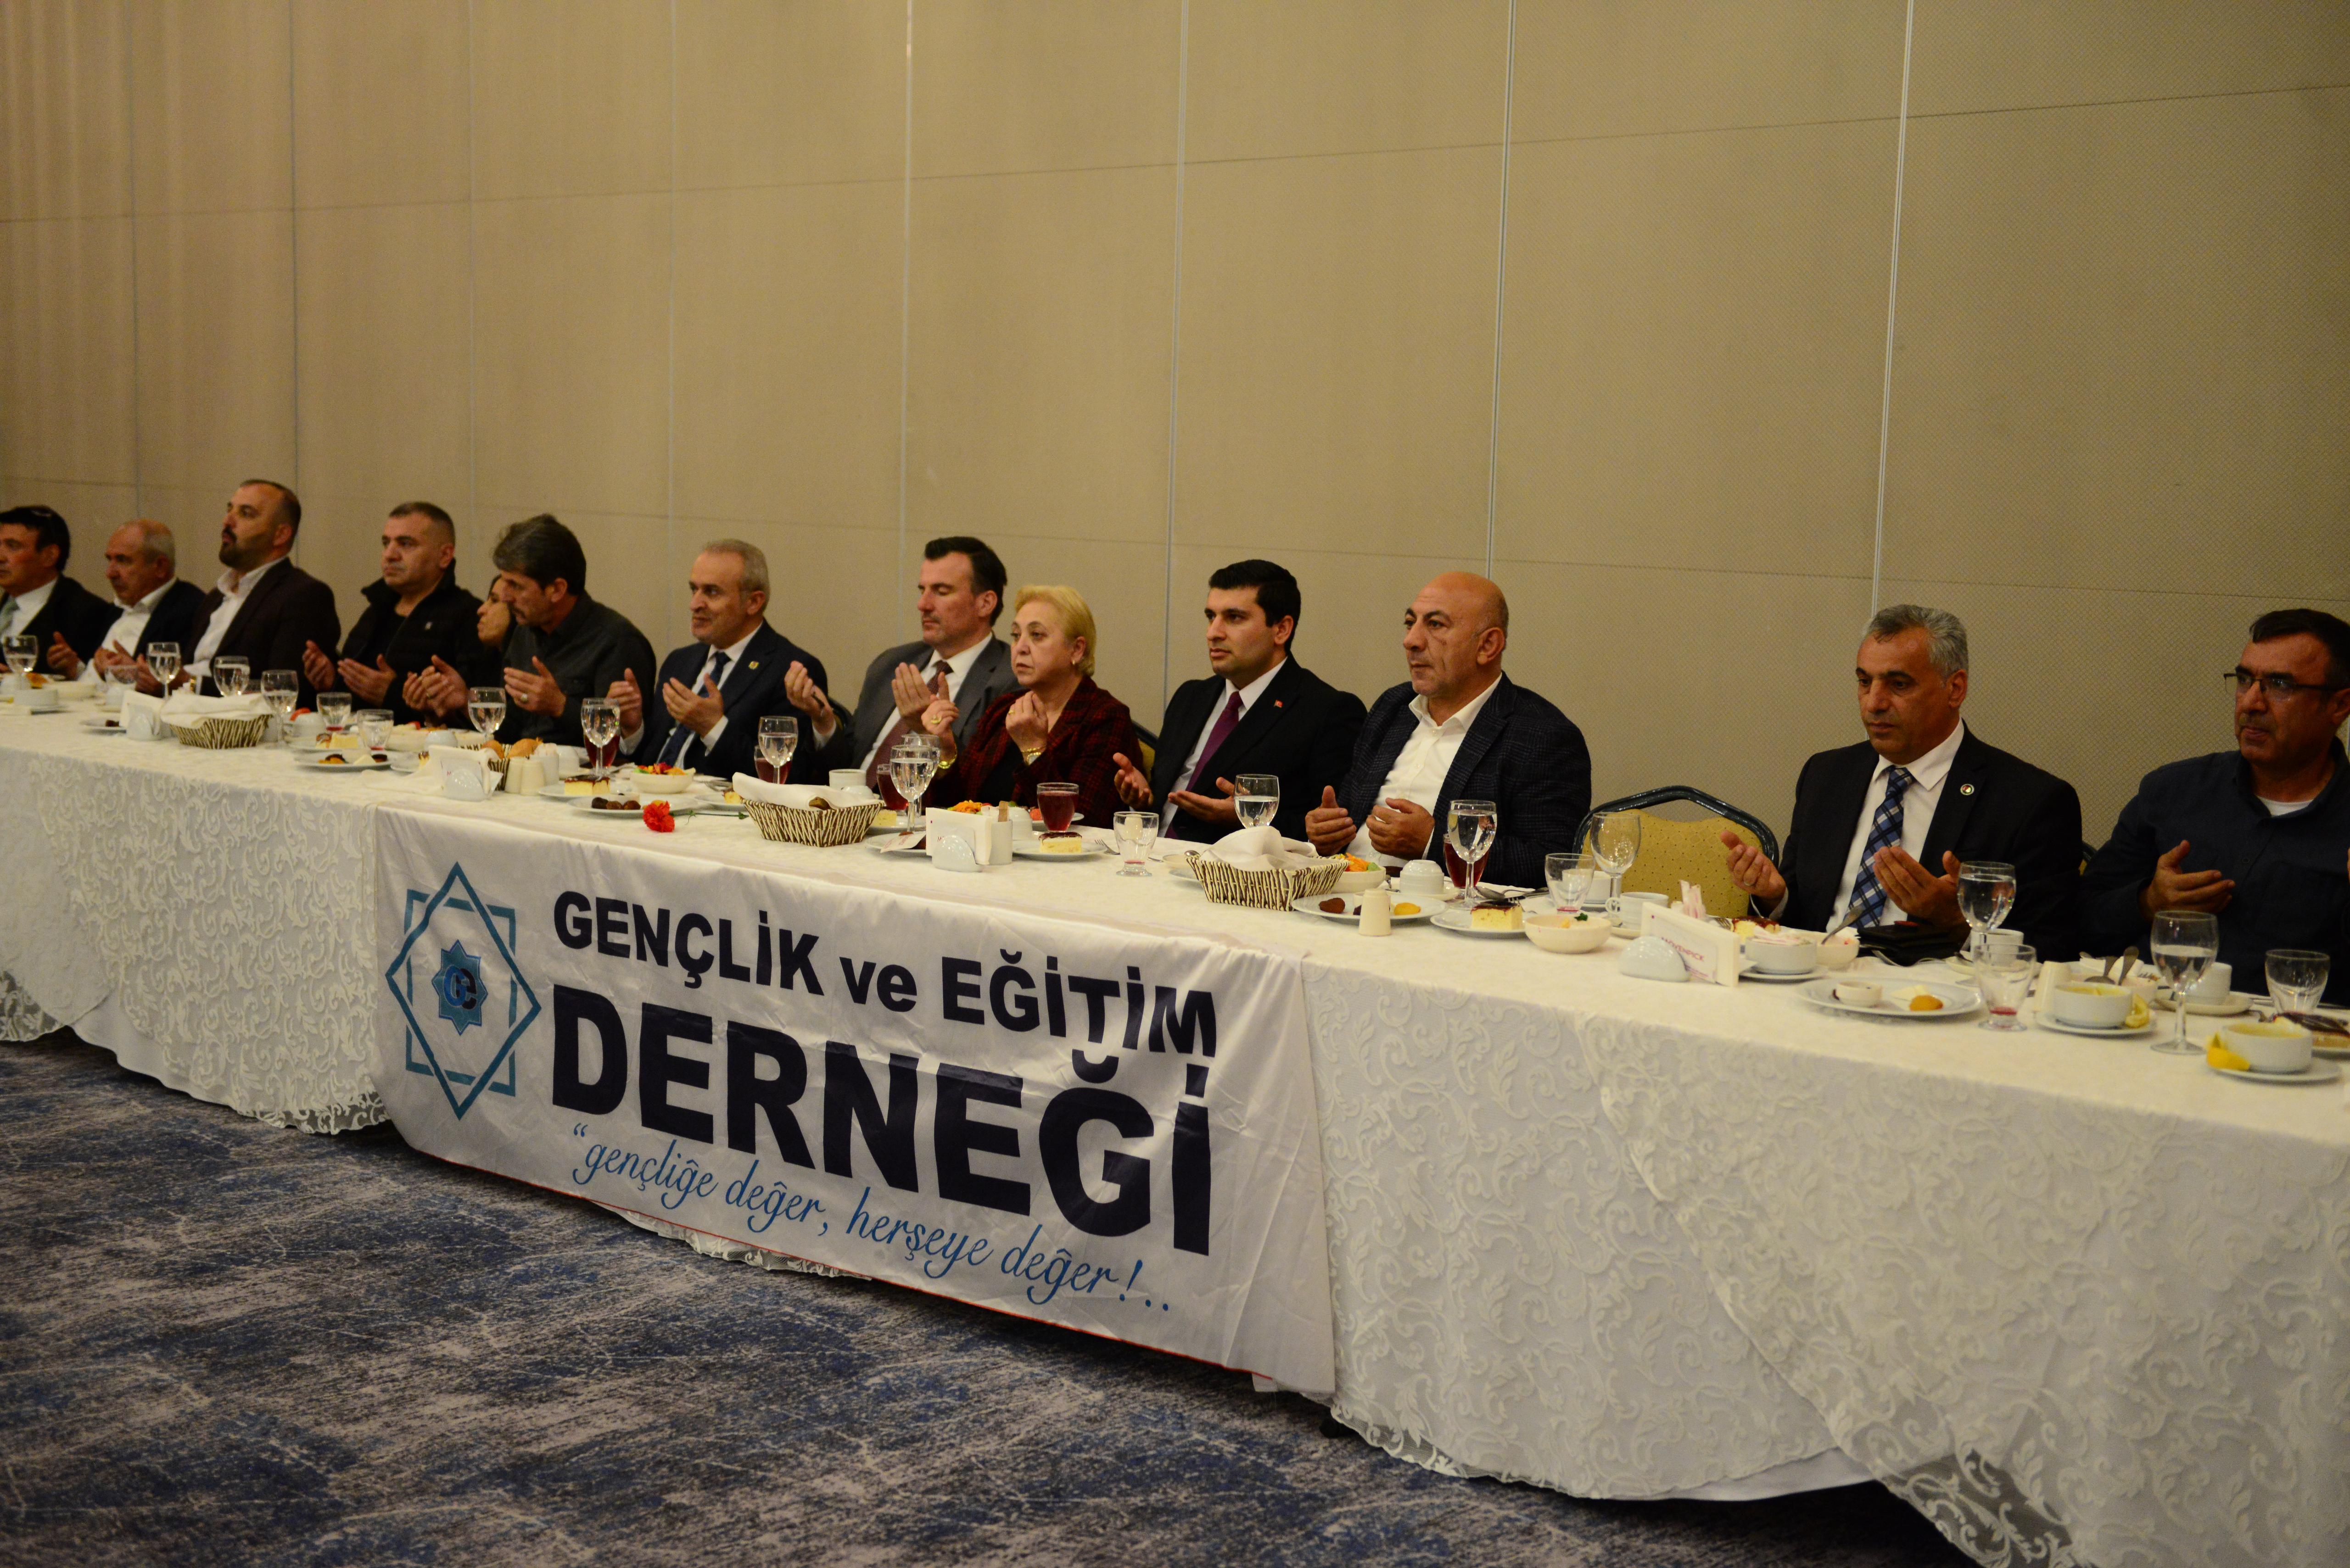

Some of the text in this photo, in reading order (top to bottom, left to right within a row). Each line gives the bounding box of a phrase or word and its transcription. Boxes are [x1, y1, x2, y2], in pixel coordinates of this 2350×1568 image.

[554, 891, 1217, 1058] GENÇLİK ve EĞİTİM
[553, 984, 1212, 1256] DERNEĞİ
[846, 1187, 994, 1279] herşeye
